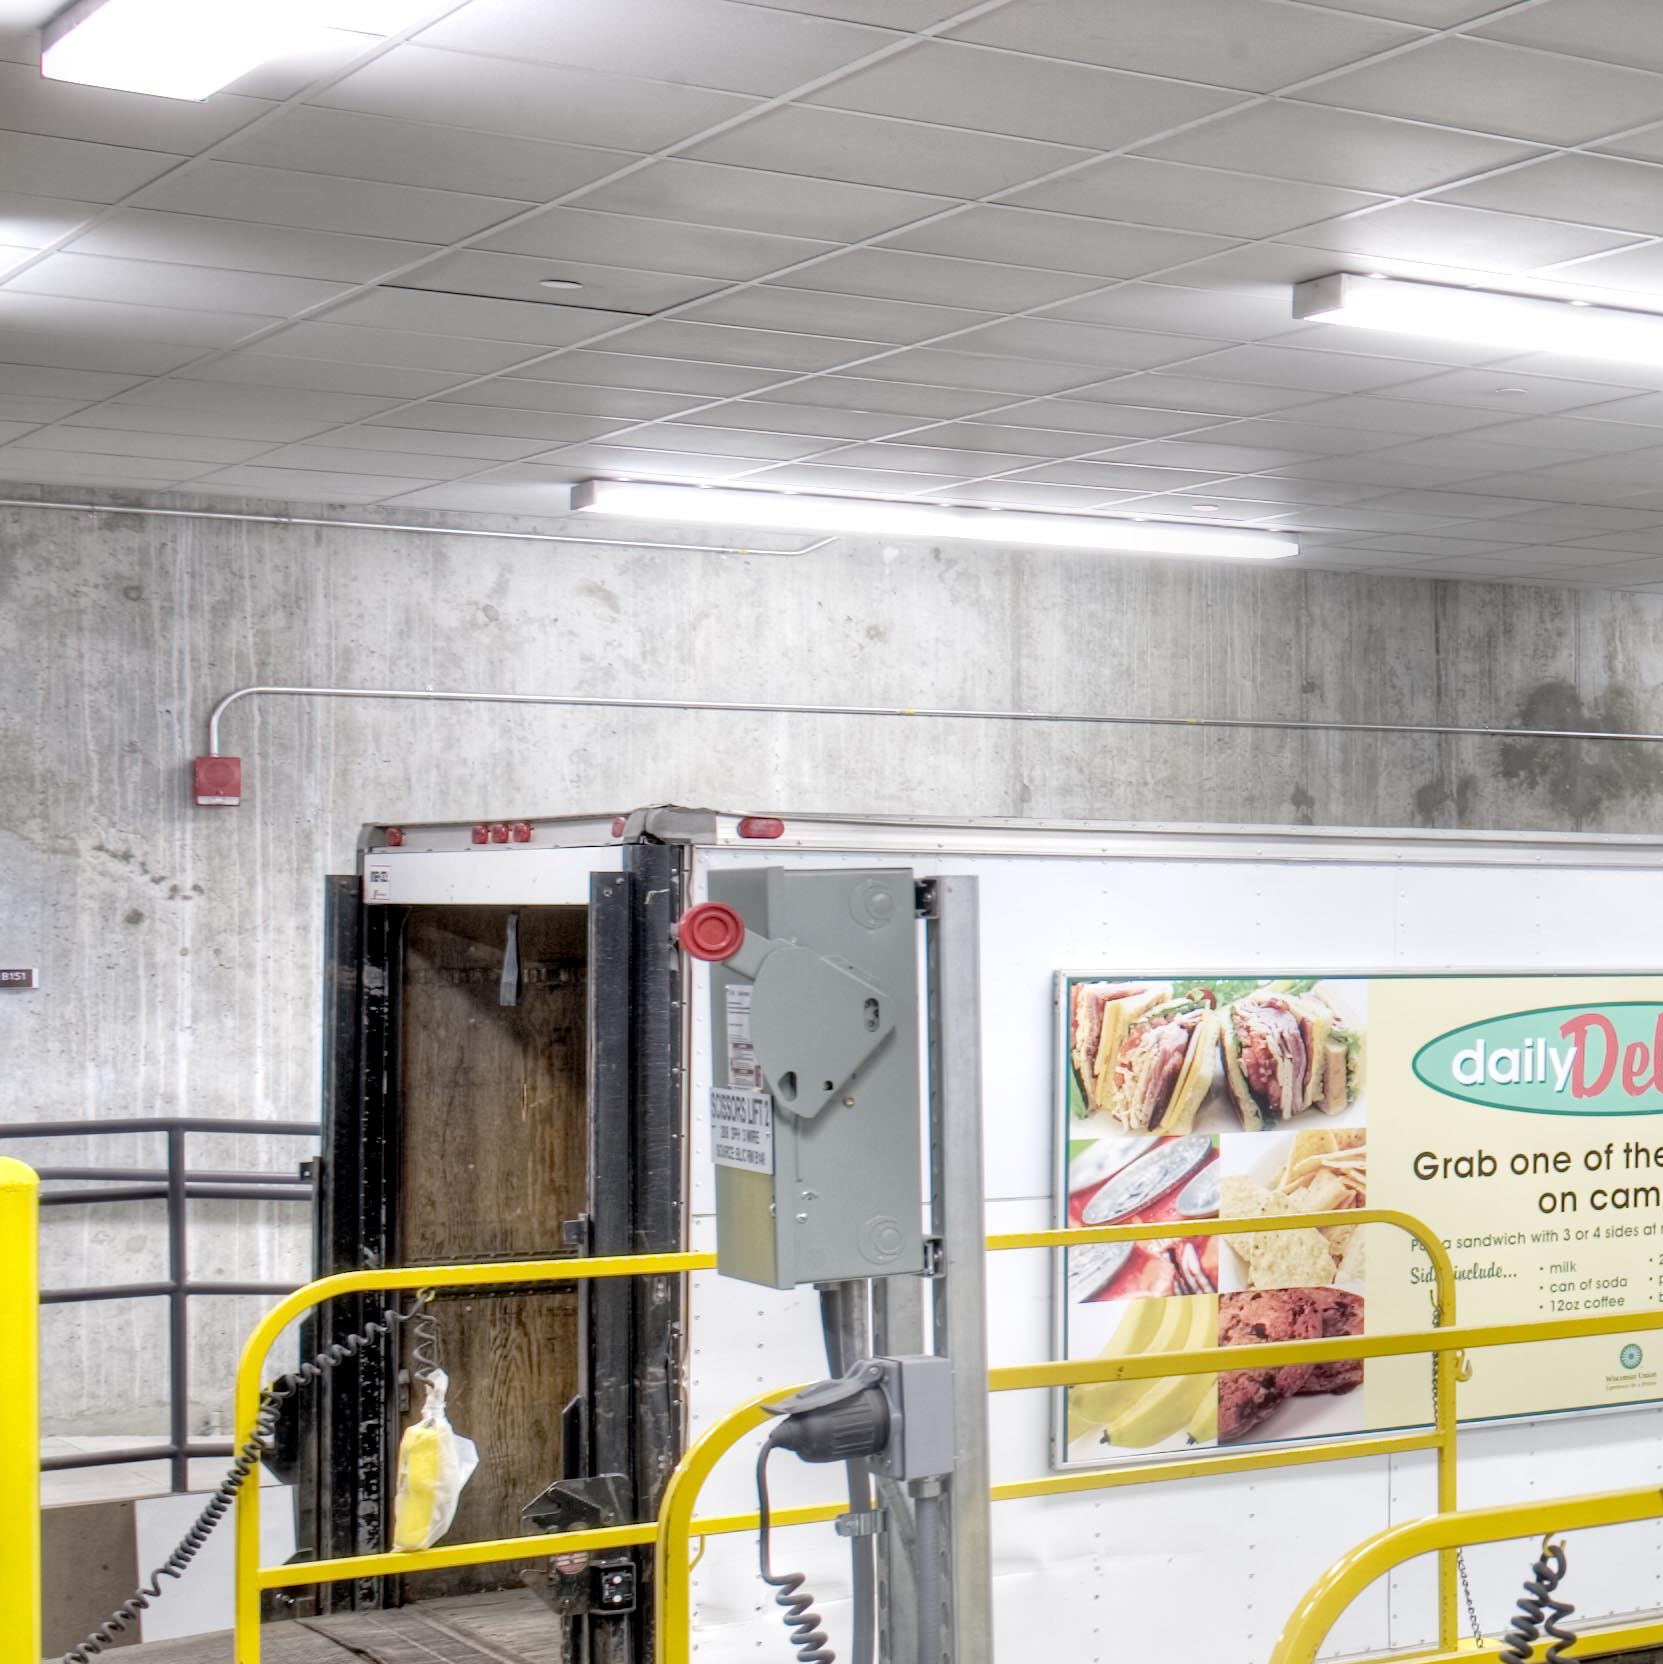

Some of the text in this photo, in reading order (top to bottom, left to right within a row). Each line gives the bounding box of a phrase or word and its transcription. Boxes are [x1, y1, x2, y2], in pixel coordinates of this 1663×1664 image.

[1451, 1037, 1578, 1093] daily
[710, 1091, 747, 1122] SCISSORS
[747, 1095, 763, 1127] LIFT
[1413, 1149, 1498, 1182] Grab
[1510, 1150, 1572, 1176] one
[1584, 1142, 1614, 1171] of
[1538, 1187, 1577, 1214] on
[1456, 1231, 1526, 1249] sandwich
[1531, 1229, 1559, 1243] with
[1563, 1228, 1571, 1241] 3
[1575, 1229, 1589, 1241] or
[1593, 1226, 1601, 1238] 4
[1605, 1224, 1639, 1239] sides
[1643, 1222, 1656, 1236] at
[1410, 1262, 1518, 1284] Sid include...
[1549, 1261, 1577, 1274] milk
[1549, 1276, 1628, 1293] can of soda
[1550, 1296, 1625, 1312] 12oz coffee
